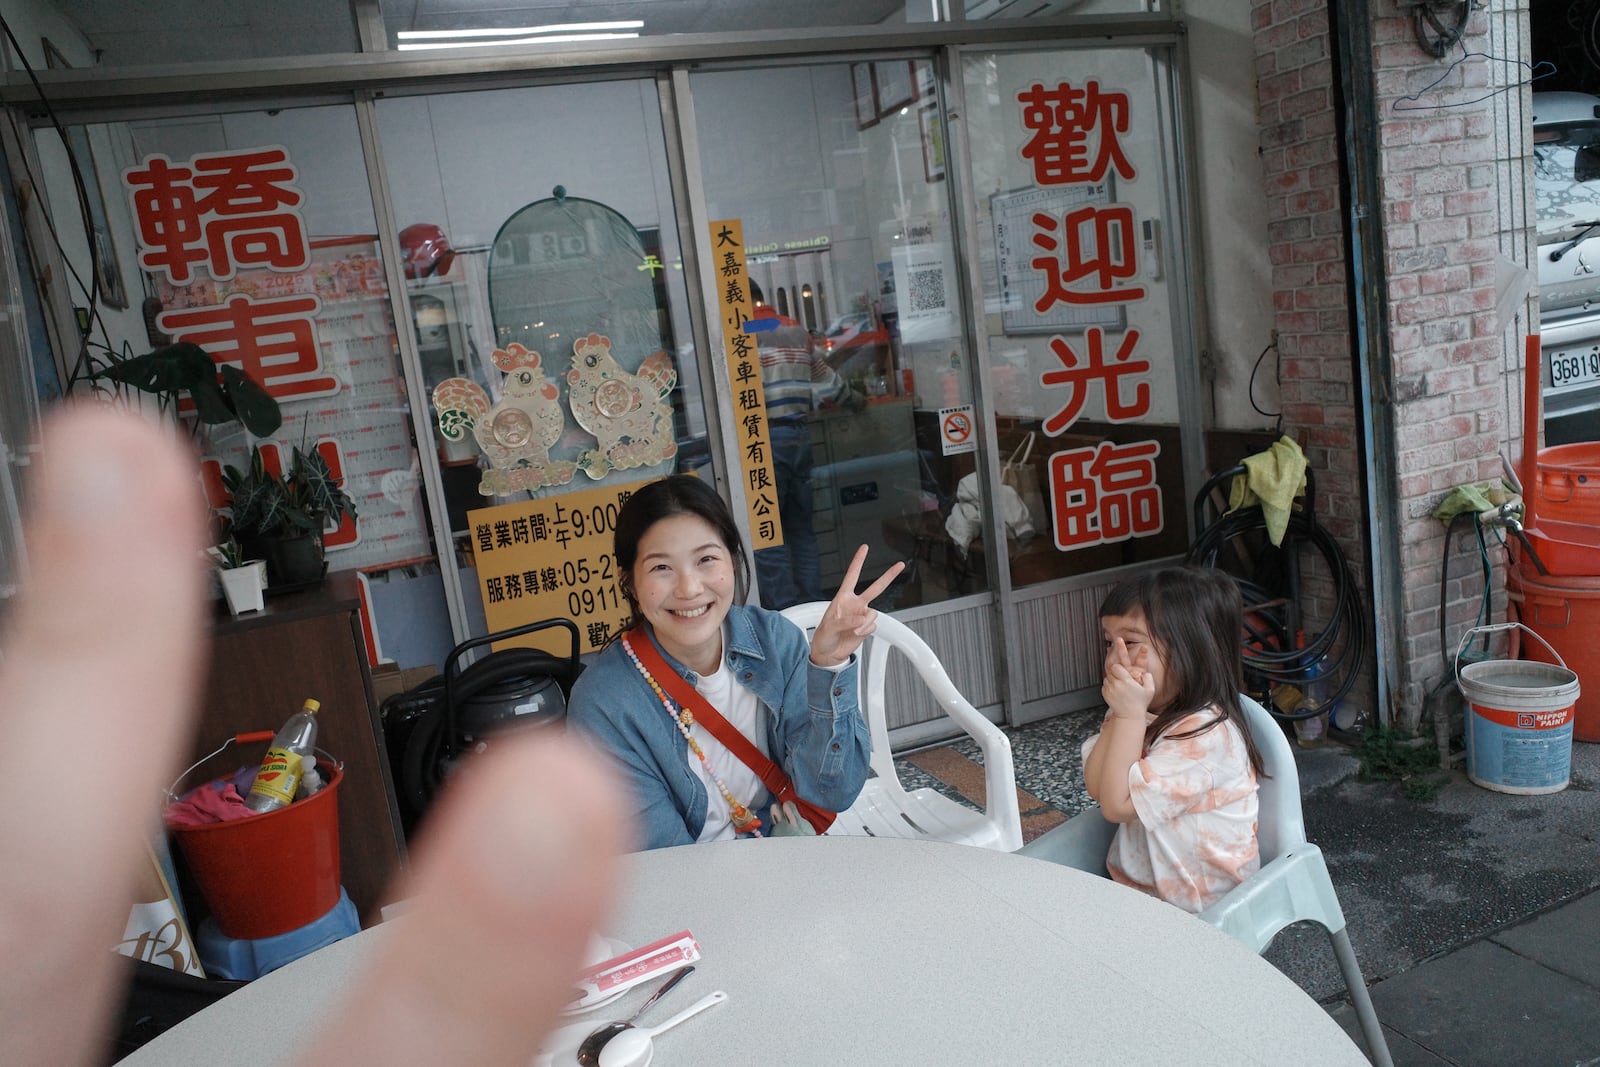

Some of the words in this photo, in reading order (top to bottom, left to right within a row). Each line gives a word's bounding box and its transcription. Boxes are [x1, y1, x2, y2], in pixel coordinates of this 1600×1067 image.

[1017, 79, 1164, 550] 歡迎光臨
[717, 225, 776, 541] 大嘉義小客車租賃有限公司
[568, 582, 626, 617] 0911
[1536, 711, 1568, 721] NIPPON
[1540, 718, 1565, 727] PAINT
